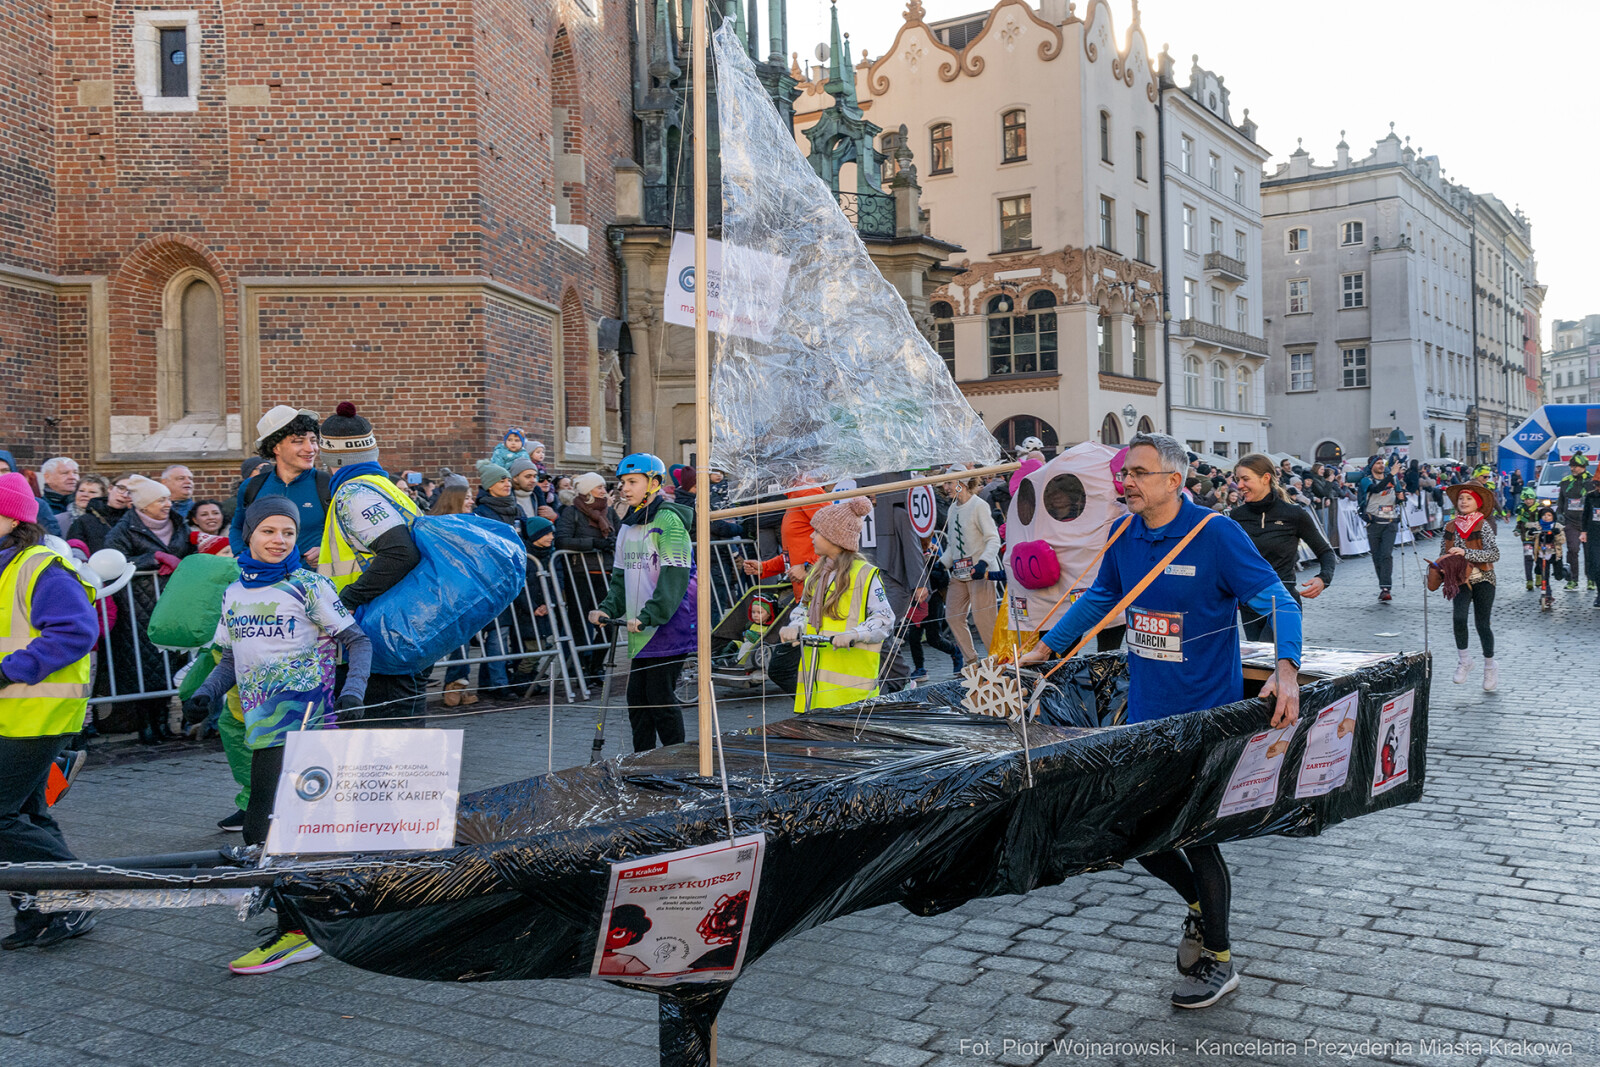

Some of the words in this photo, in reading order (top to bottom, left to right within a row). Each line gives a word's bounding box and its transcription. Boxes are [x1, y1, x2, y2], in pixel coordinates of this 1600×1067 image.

[1529, 433, 1544, 441] ZIS
[912, 493, 929, 519] 50
[1135, 614, 1168, 634] 2589
[234, 626, 285, 639] BIEGAJĄ
[1135, 632, 1166, 648] MARCIN
[337, 764, 393, 772] SPECJALISTYCZNA
[335, 779, 409, 790] KRAKOWSKI
[334, 789, 393, 802] OŚRODEK
[397, 790, 446, 801] KARIERY
[298, 817, 440, 835] mamonieryzykuj.pl
[635, 866, 664, 876] Kraków
[629, 871, 742, 894] ZARYZYKUJESZ?
